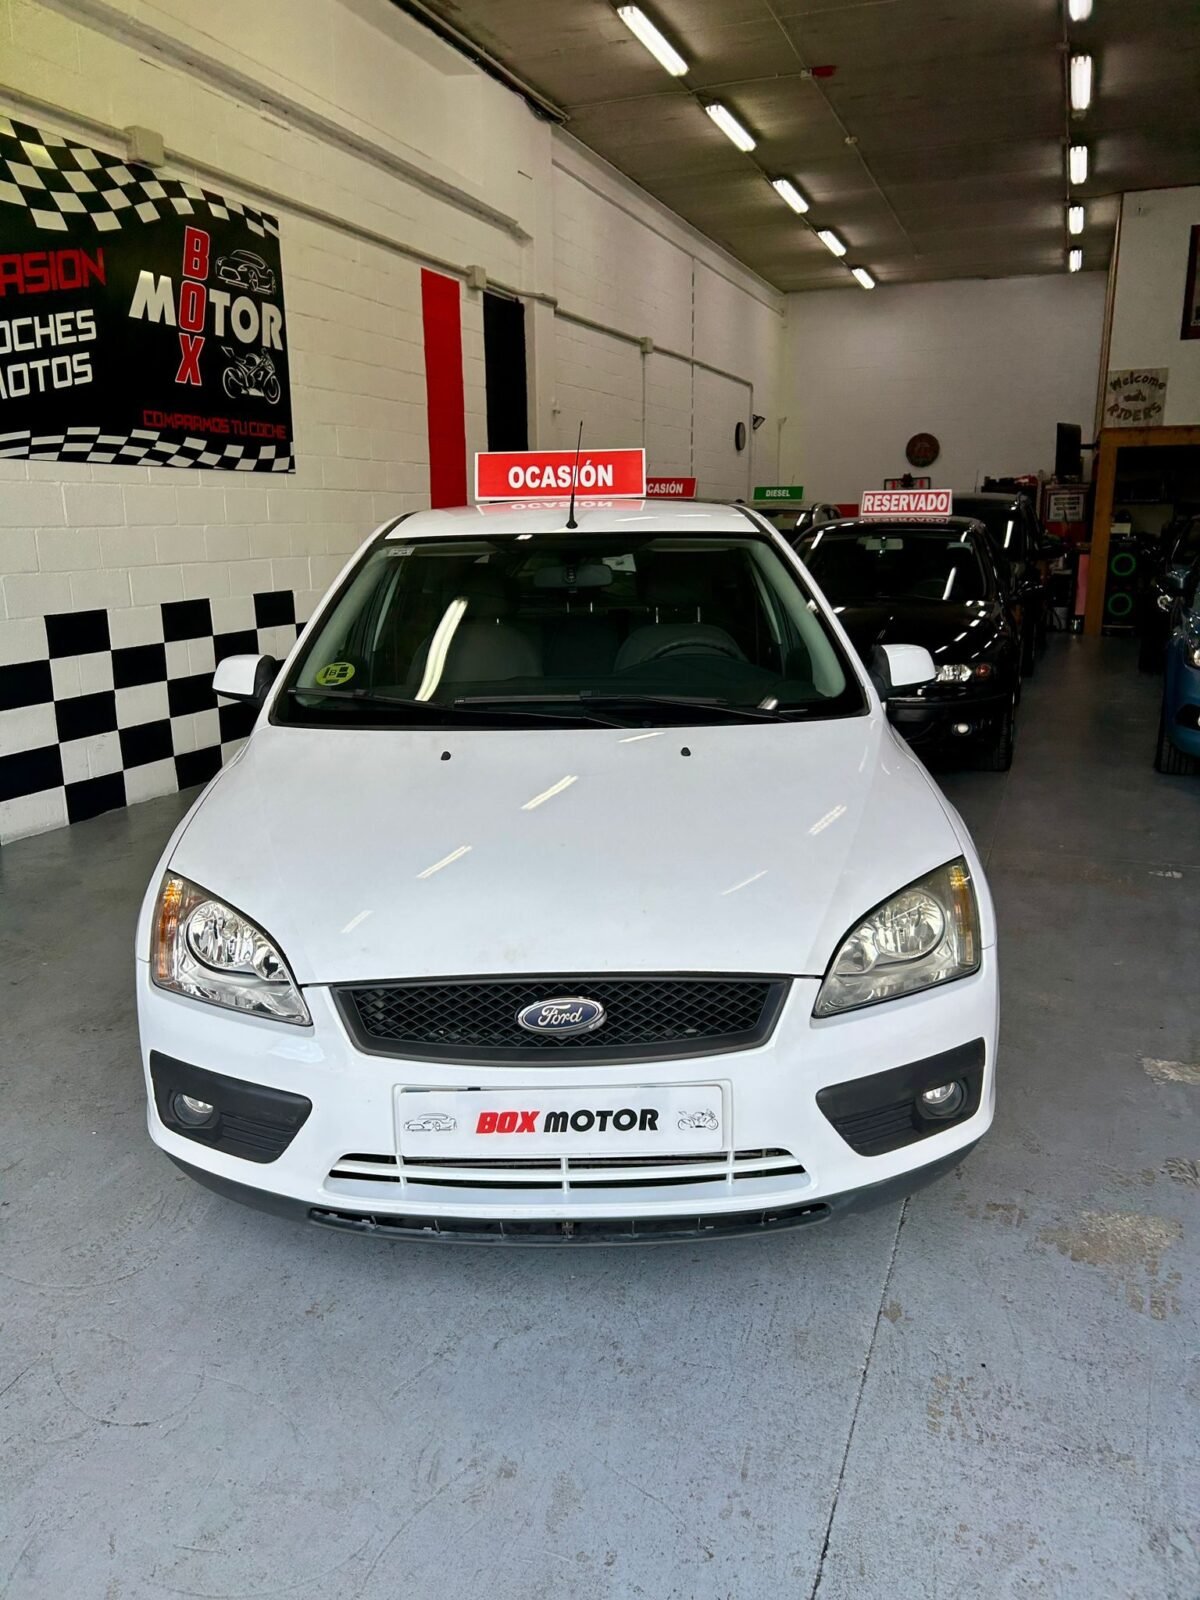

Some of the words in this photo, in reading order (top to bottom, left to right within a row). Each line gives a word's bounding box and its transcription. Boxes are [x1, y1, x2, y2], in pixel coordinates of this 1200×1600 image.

[175, 225, 210, 386] BOX
[0, 352, 93, 400] OTOS
[1110, 371, 1167, 391] Welcome
[508, 460, 613, 488] OCASIÓN
[646, 481, 683, 494] CASIÓN
[765, 489, 790, 497] DIESEL
[863, 493, 947, 512] RESERVADO
[537, 1004, 583, 1026] Ford
[475, 1110, 540, 1134] BOX
[543, 1108, 659, 1132] MOTOR
